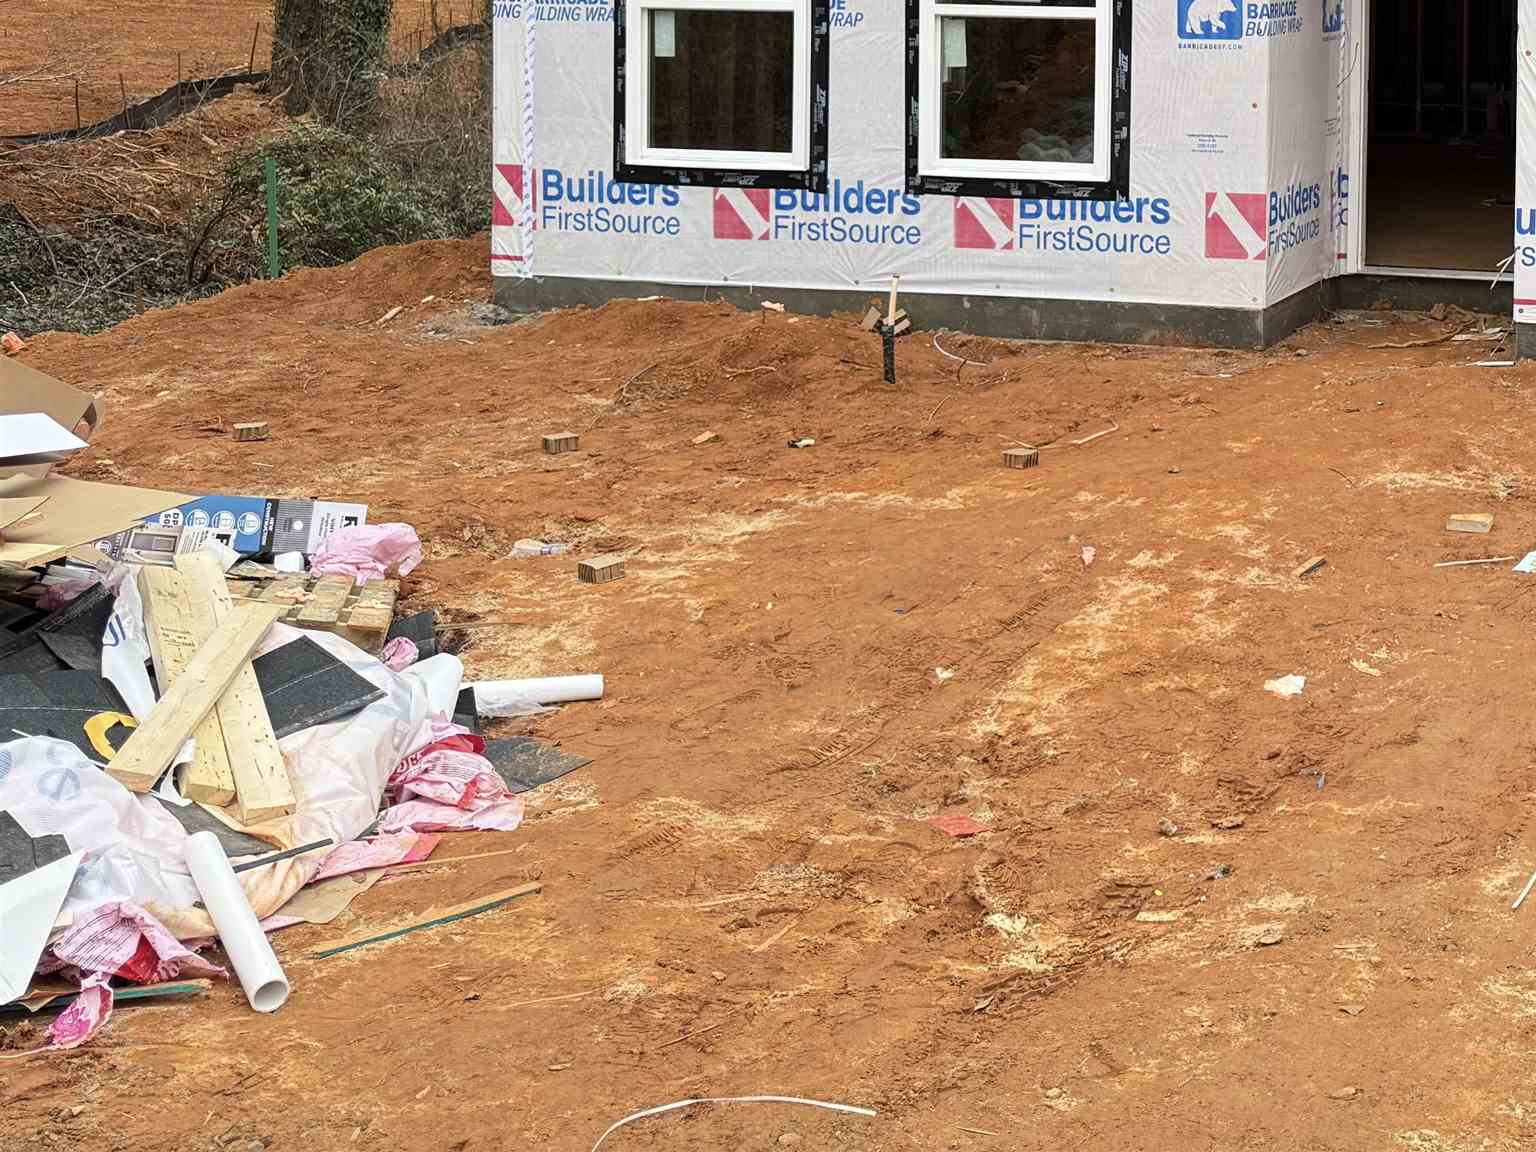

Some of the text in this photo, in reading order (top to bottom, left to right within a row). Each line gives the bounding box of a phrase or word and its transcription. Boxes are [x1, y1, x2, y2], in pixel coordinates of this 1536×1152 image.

[542, 169, 680, 206] Builders
[1269, 181, 1320, 226] Builders
[542, 206, 681, 235] FirstSource
[774, 215, 921, 245] FirstSource
[1018, 224, 1171, 255] FirstSource
